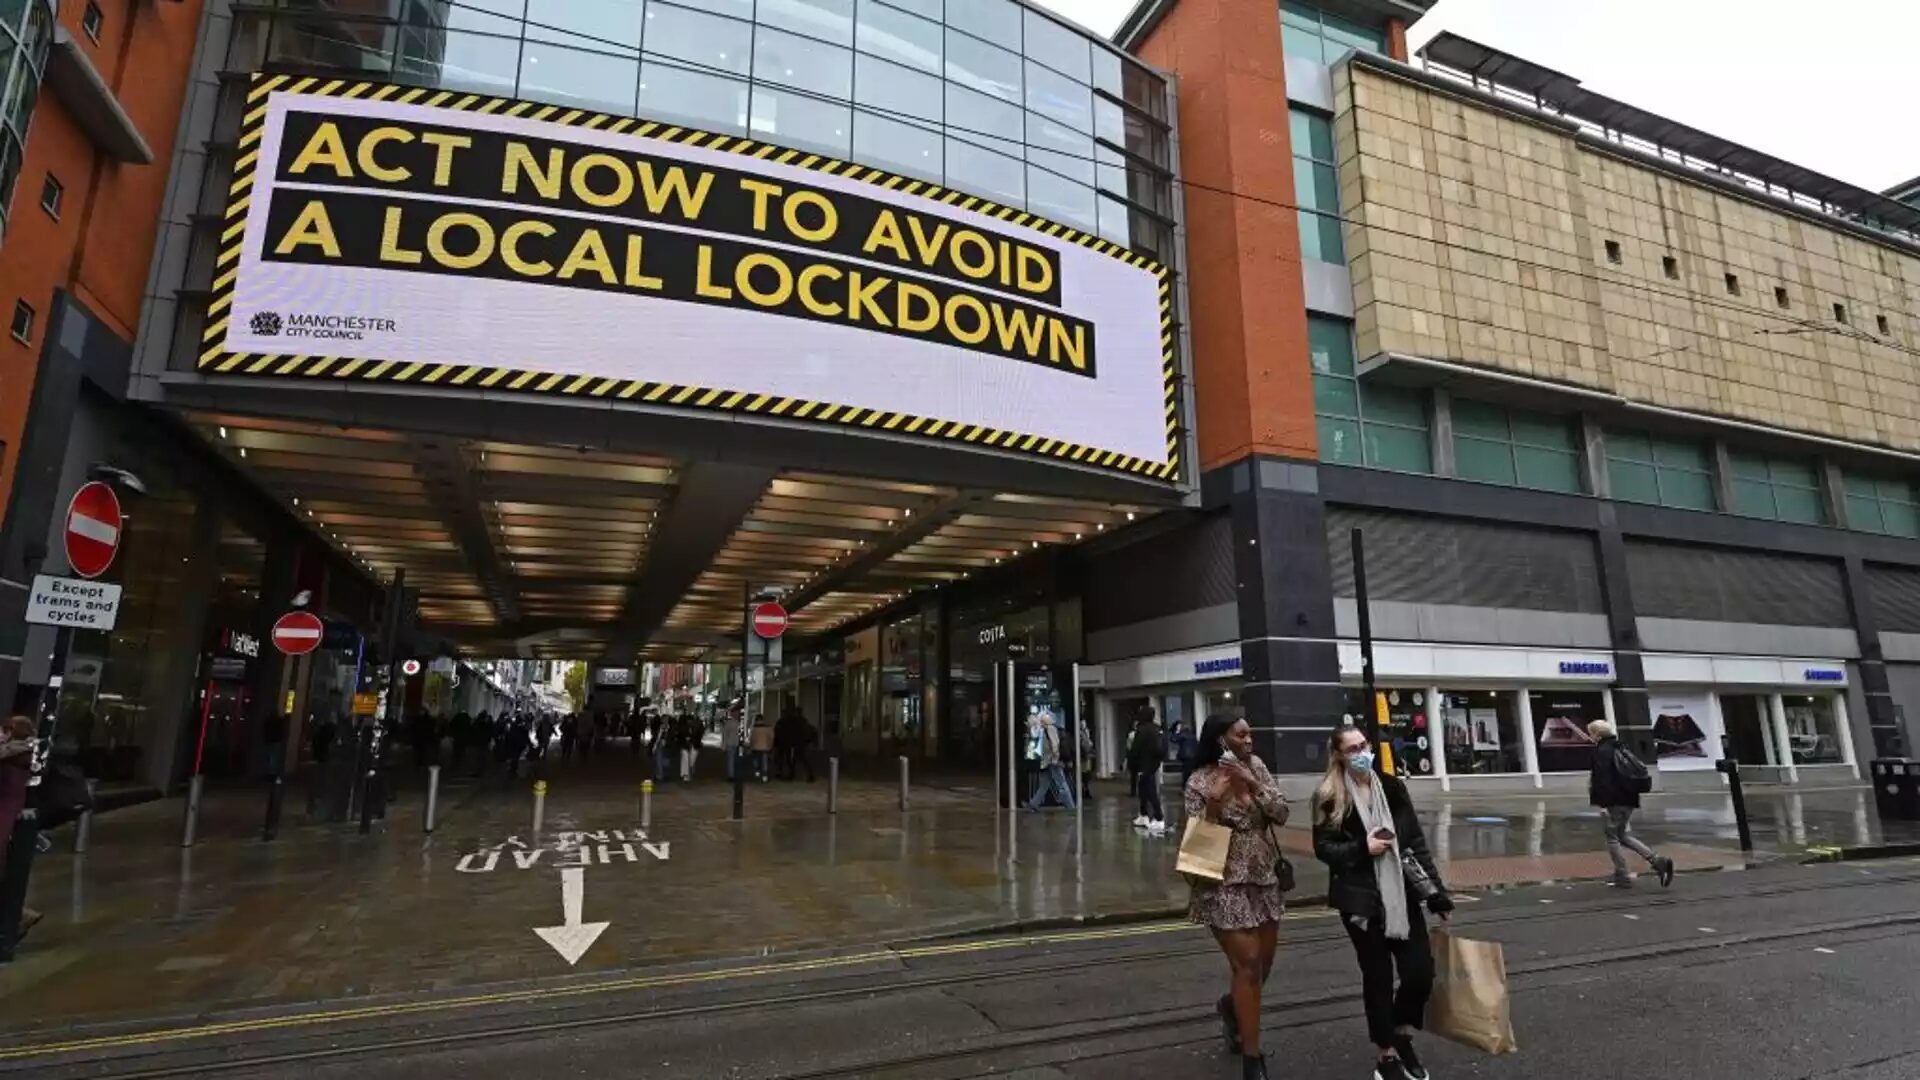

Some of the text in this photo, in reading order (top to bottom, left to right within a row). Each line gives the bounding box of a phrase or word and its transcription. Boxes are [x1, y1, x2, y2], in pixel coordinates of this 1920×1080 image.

[289, 121, 1054, 294] ACT NOW TO AVOID
[274, 200, 1086, 369] A LOCAL LOCKDOWN
[288, 313, 397, 332] MANCHESTER
[286, 327, 364, 340] CITY COUNCIL
[52, 581, 104, 598] Except
[36, 593, 113, 612] trams and
[48, 610, 96, 623] cycles
[980, 625, 1006, 644] COSTA
[1559, 661, 1609, 674] SAMSUNG
[455, 841, 671, 873] AHEAD
